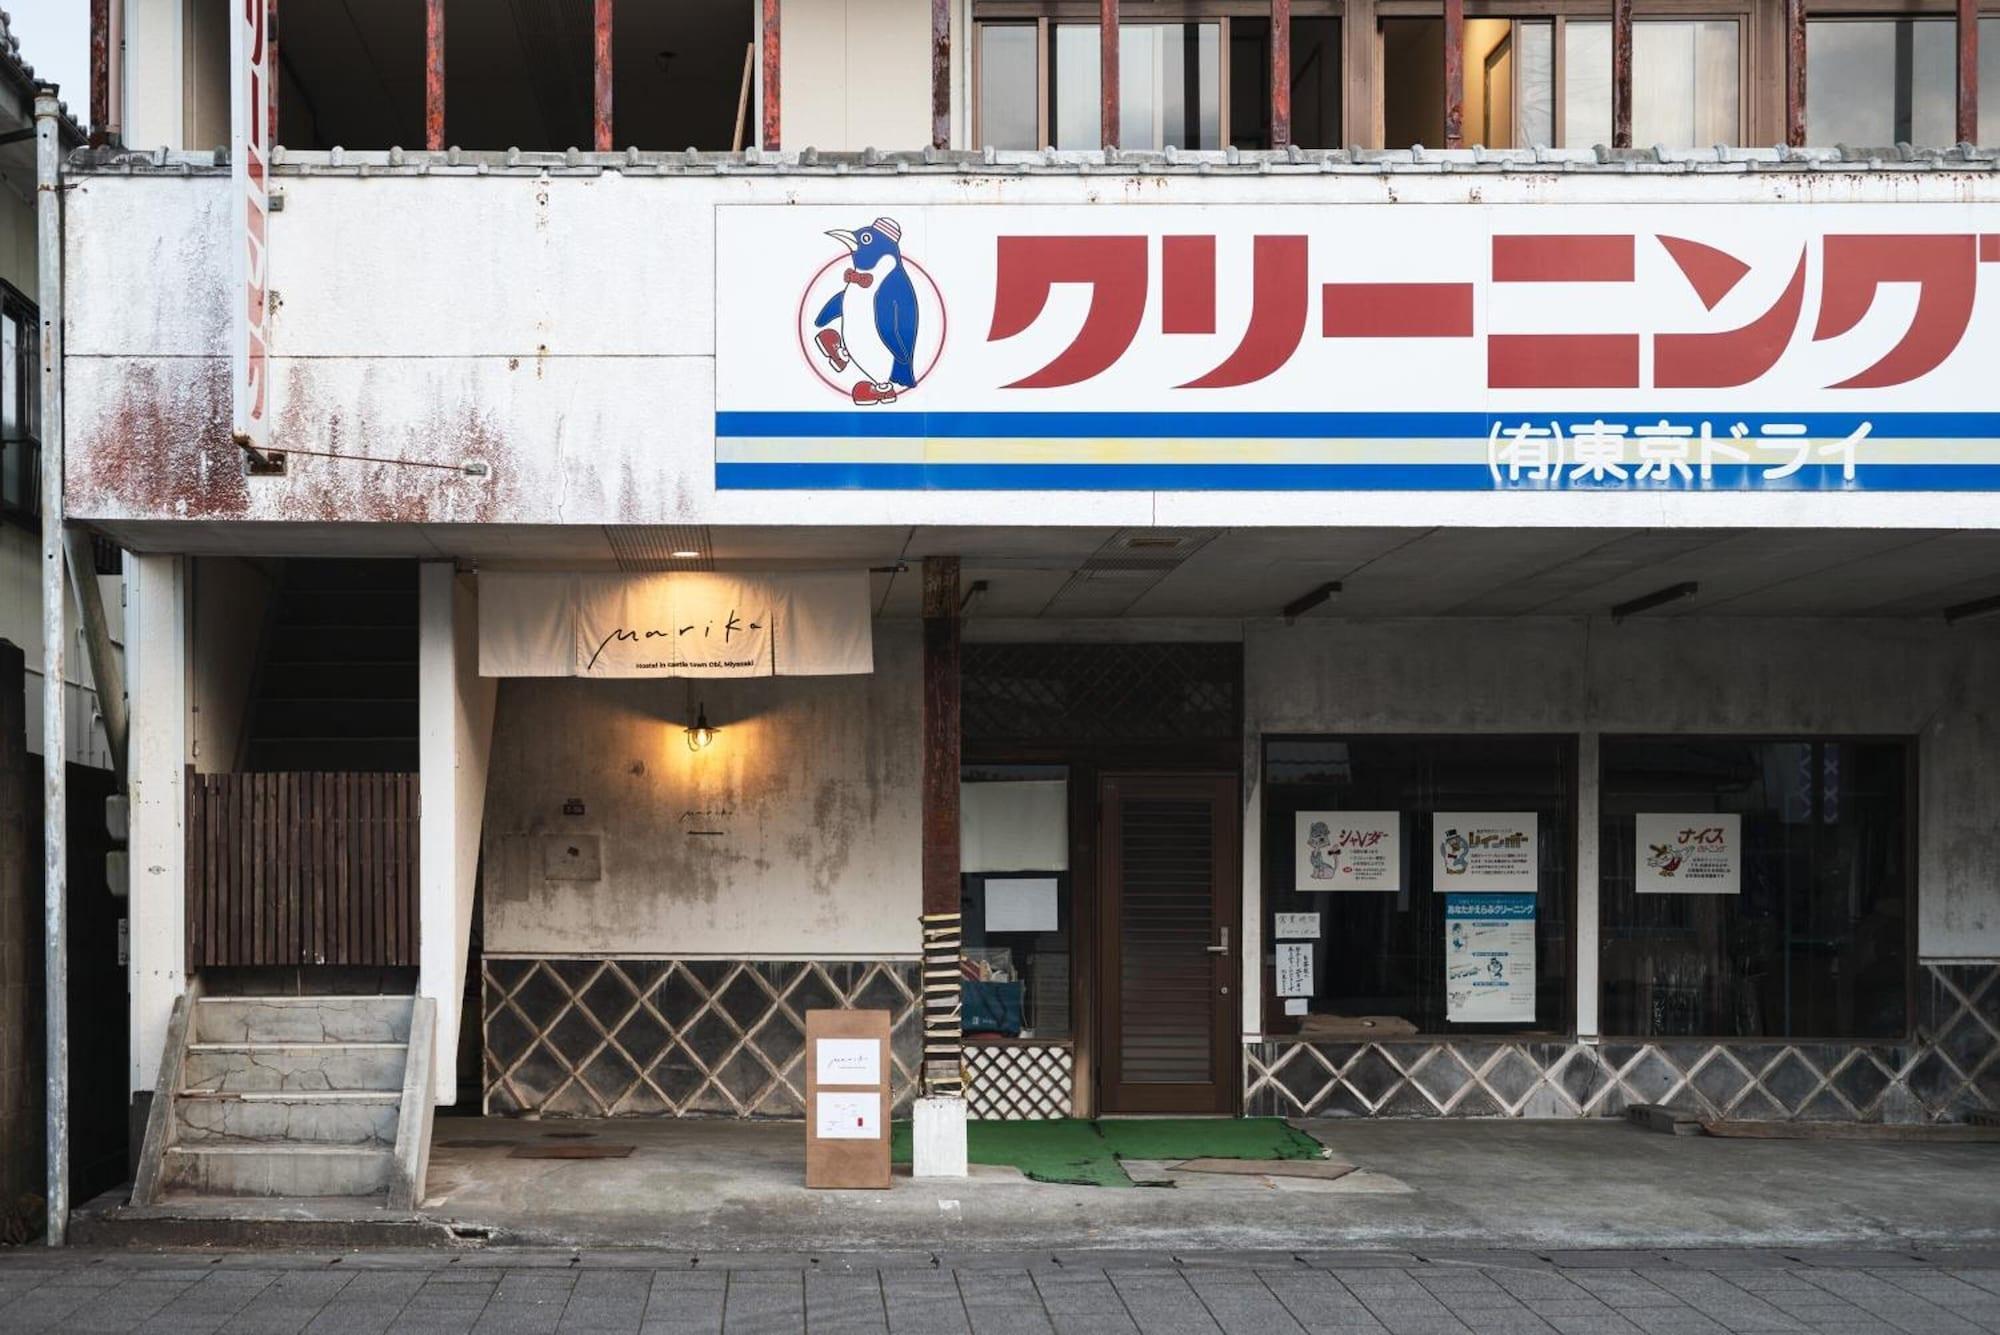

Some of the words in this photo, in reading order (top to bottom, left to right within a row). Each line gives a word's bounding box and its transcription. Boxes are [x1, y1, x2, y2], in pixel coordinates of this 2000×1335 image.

[1488, 419, 1873, 483] (有)東京ドライ
[587, 608, 762, 670] marika
[724, 660, 754, 669] Miyazaki
[1469, 831, 1529, 849] レインボー
[1678, 827, 1725, 844] ナイス
